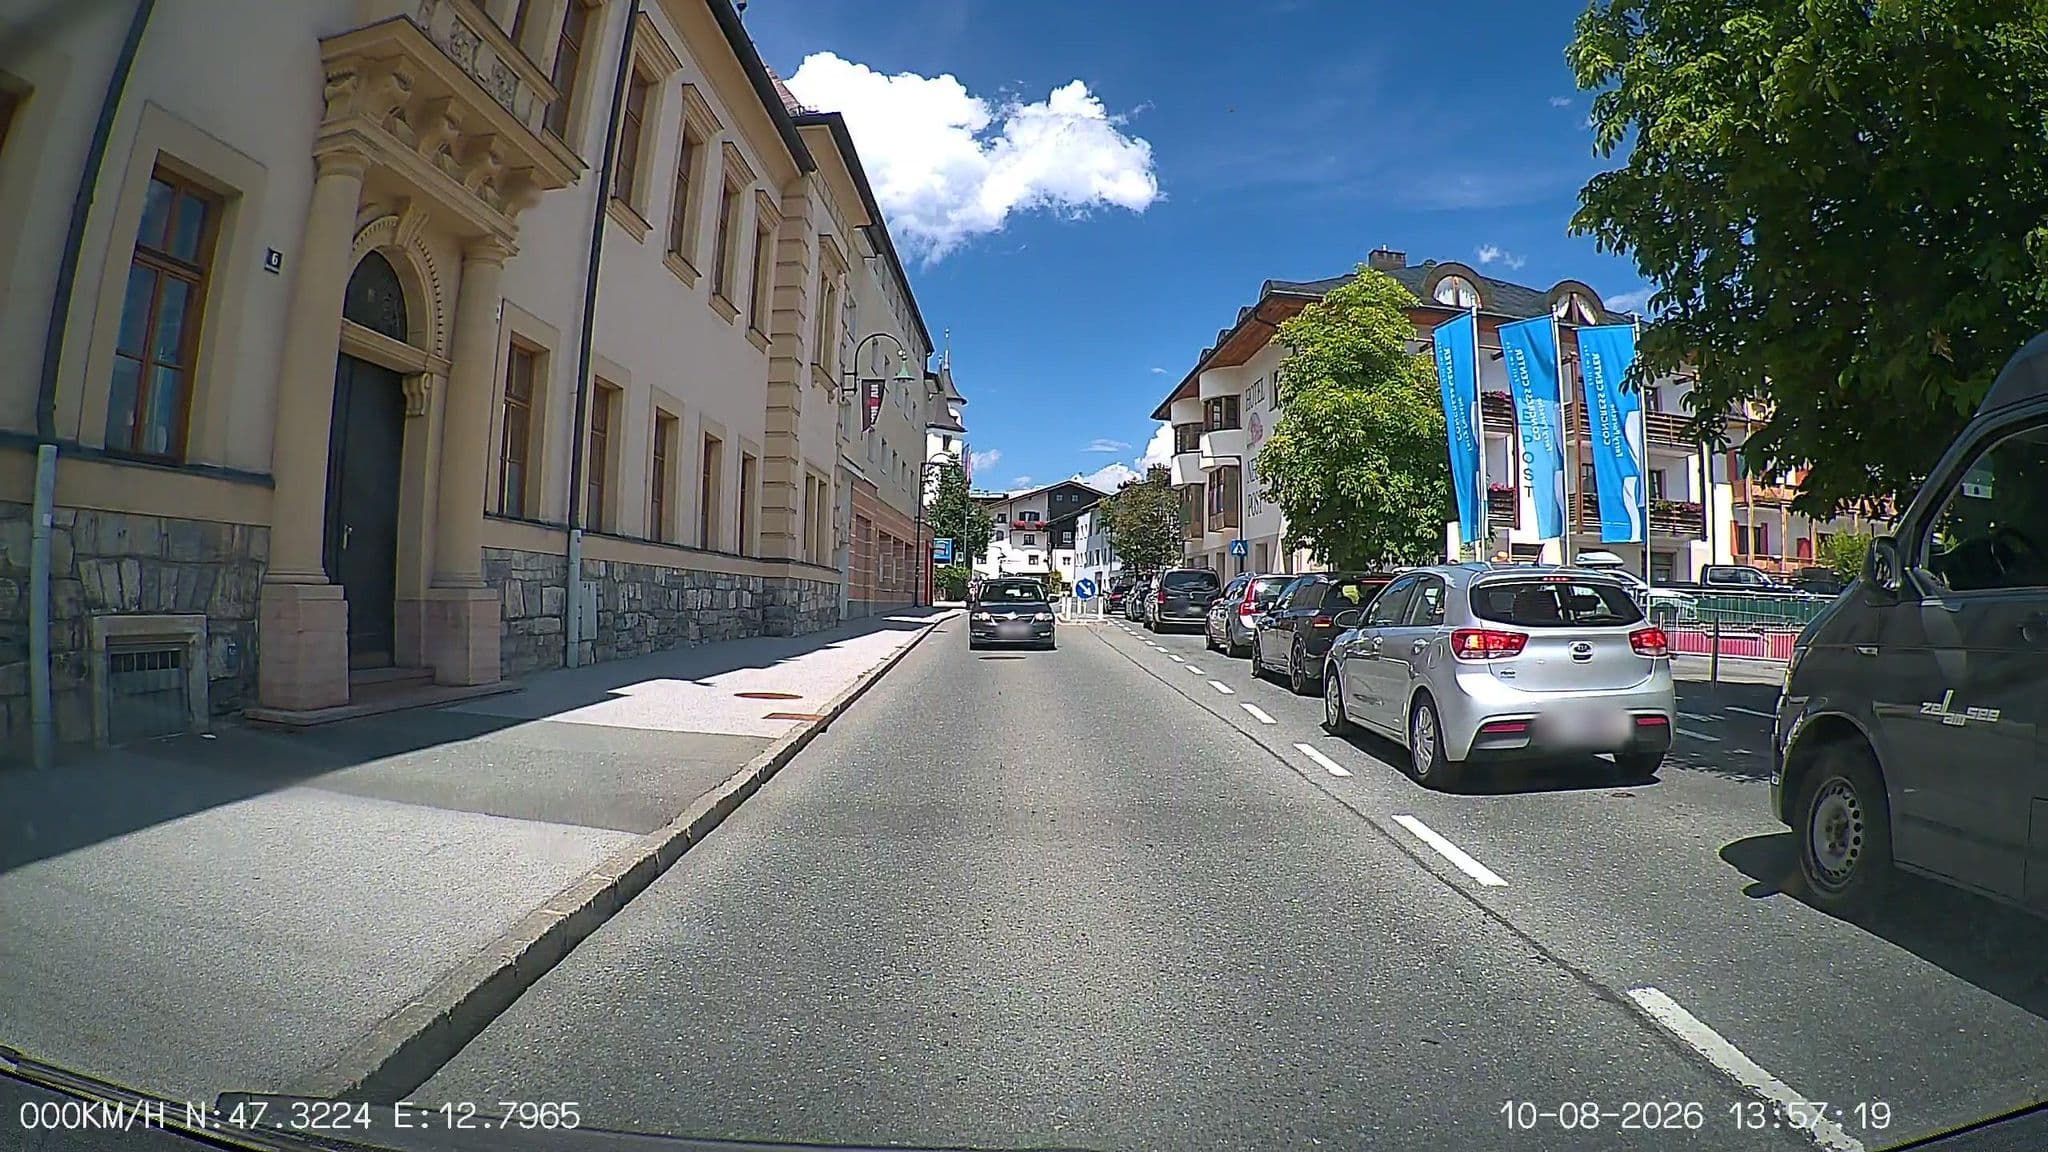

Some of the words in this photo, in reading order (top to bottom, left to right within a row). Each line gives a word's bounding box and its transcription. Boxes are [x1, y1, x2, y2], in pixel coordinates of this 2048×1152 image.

[272, 253, 279, 265] 6
[1245, 378, 1265, 411] HOTEL
[1943, 713, 1966, 726] am
